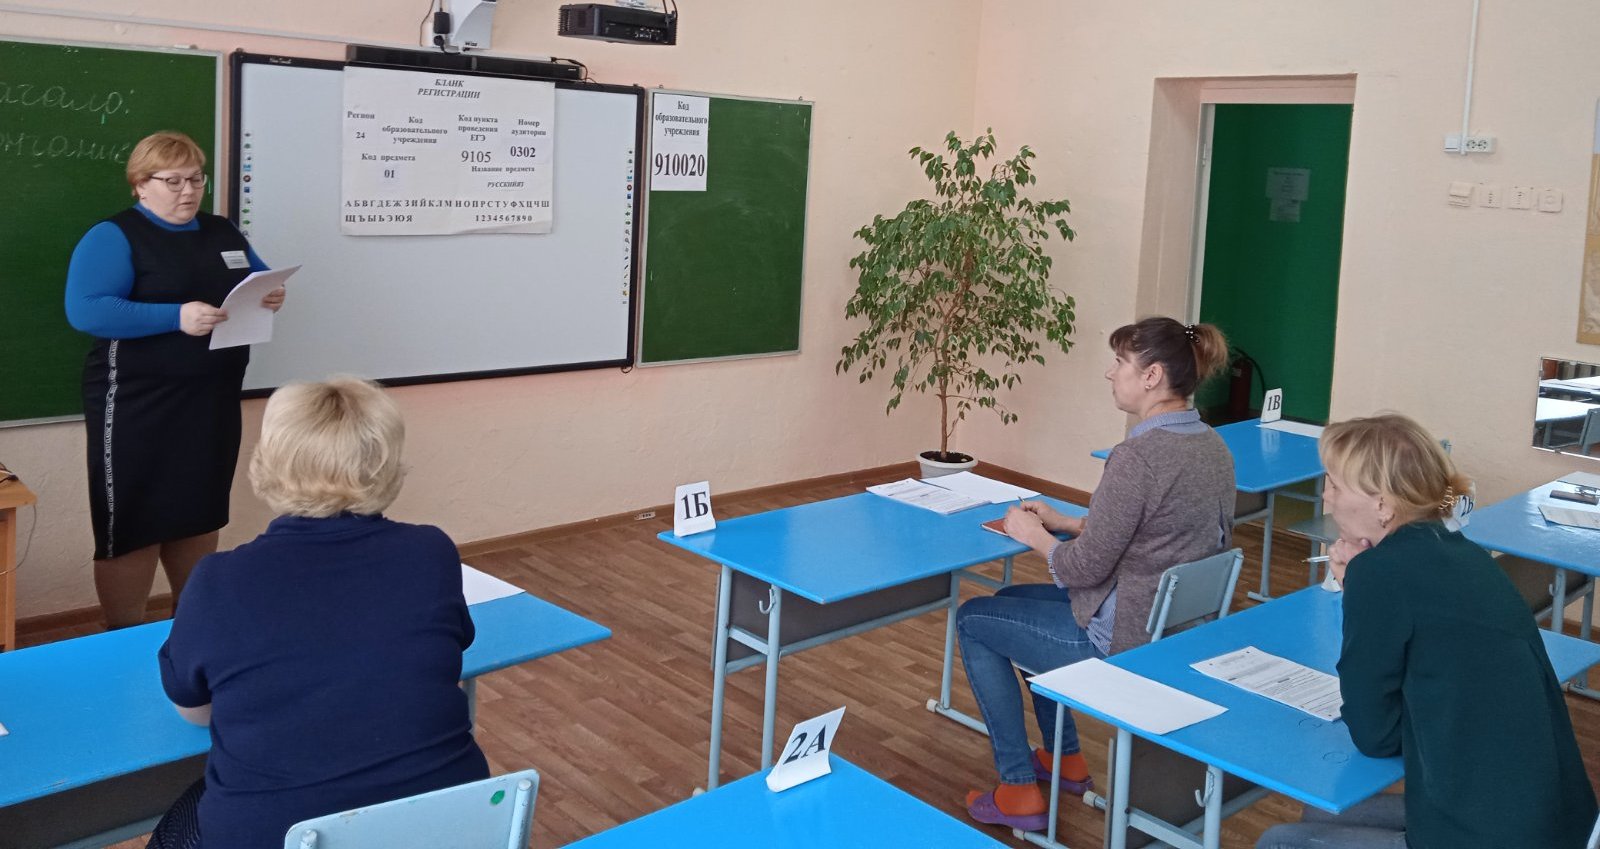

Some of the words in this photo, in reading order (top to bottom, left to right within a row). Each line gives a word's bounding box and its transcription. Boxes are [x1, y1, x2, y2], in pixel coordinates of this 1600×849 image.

[435, 78, 464, 87] БЛАНК
[417, 88, 480, 99] РЕГИСТРАЦИИ
[677, 100, 690, 111] Код
[347, 110, 375, 120] Регион
[408, 116, 423, 124] Код
[458, 114, 472, 122] Код
[473, 116, 498, 125] пункта
[655, 112, 708, 124] образовательного
[518, 118, 540, 128] Номер
[382, 125, 448, 135] образовательного
[458, 125, 498, 133] проведения
[511, 129, 547, 137] аудитории
[664, 127, 700, 137] учреждения
[355, 131, 366, 139] 24
[470, 134, 486, 142] ЕГЭ
[393, 136, 437, 145] учреждения
[461, 150, 492, 163] 9105
[510, 145, 536, 158] 0302
[361, 153, 377, 161] Код
[380, 155, 416, 163] предмета
[654, 152, 706, 177] 910020
[384, 169, 395, 179] 01
[681, 491, 709, 520] 1Б
[783, 724, 826, 766] 2А
